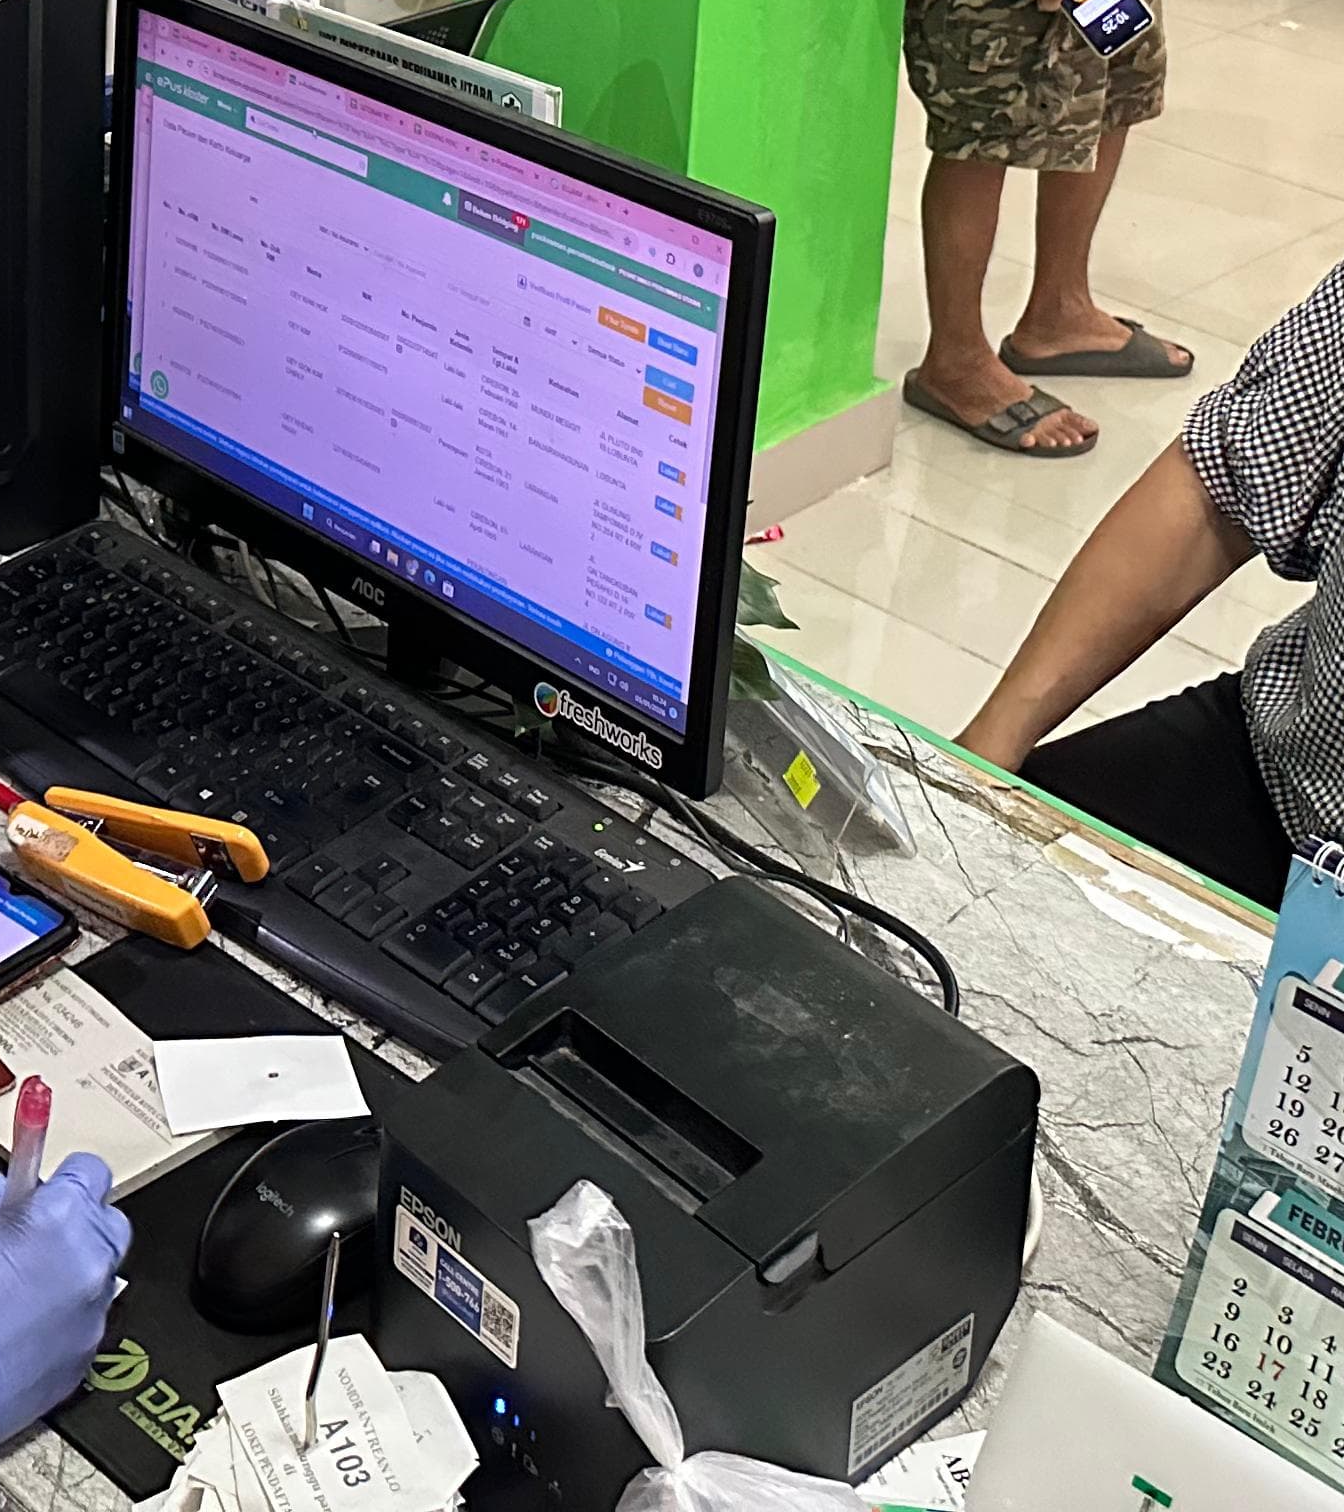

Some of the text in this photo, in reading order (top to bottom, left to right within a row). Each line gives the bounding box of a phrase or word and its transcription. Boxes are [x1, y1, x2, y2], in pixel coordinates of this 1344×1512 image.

[460, 79, 492, 102] UTARA
[352, 576, 385, 606] AOC
[559, 691, 662, 768] freshworks
[1303, 998, 1331, 1019] SENIN
[1296, 1045, 1312, 1063] 5
[1283, 1066, 1311, 1093] 12
[254, 1181, 296, 1219] logitech
[401, 1185, 461, 1252] EPSON
[1232, 1278, 1248, 1297] 2
[1278, 1306, 1294, 1325] 3
[1321, 1335, 1337, 1355] 4
[136, 1379, 197, 1444] DA
[268, 1388, 294, 1437] Silahkan
[338, 1367, 365, 1412] NOMOR
[385, 1475, 401, 1492] LO
[241, 1421, 267, 1458] LOKET
